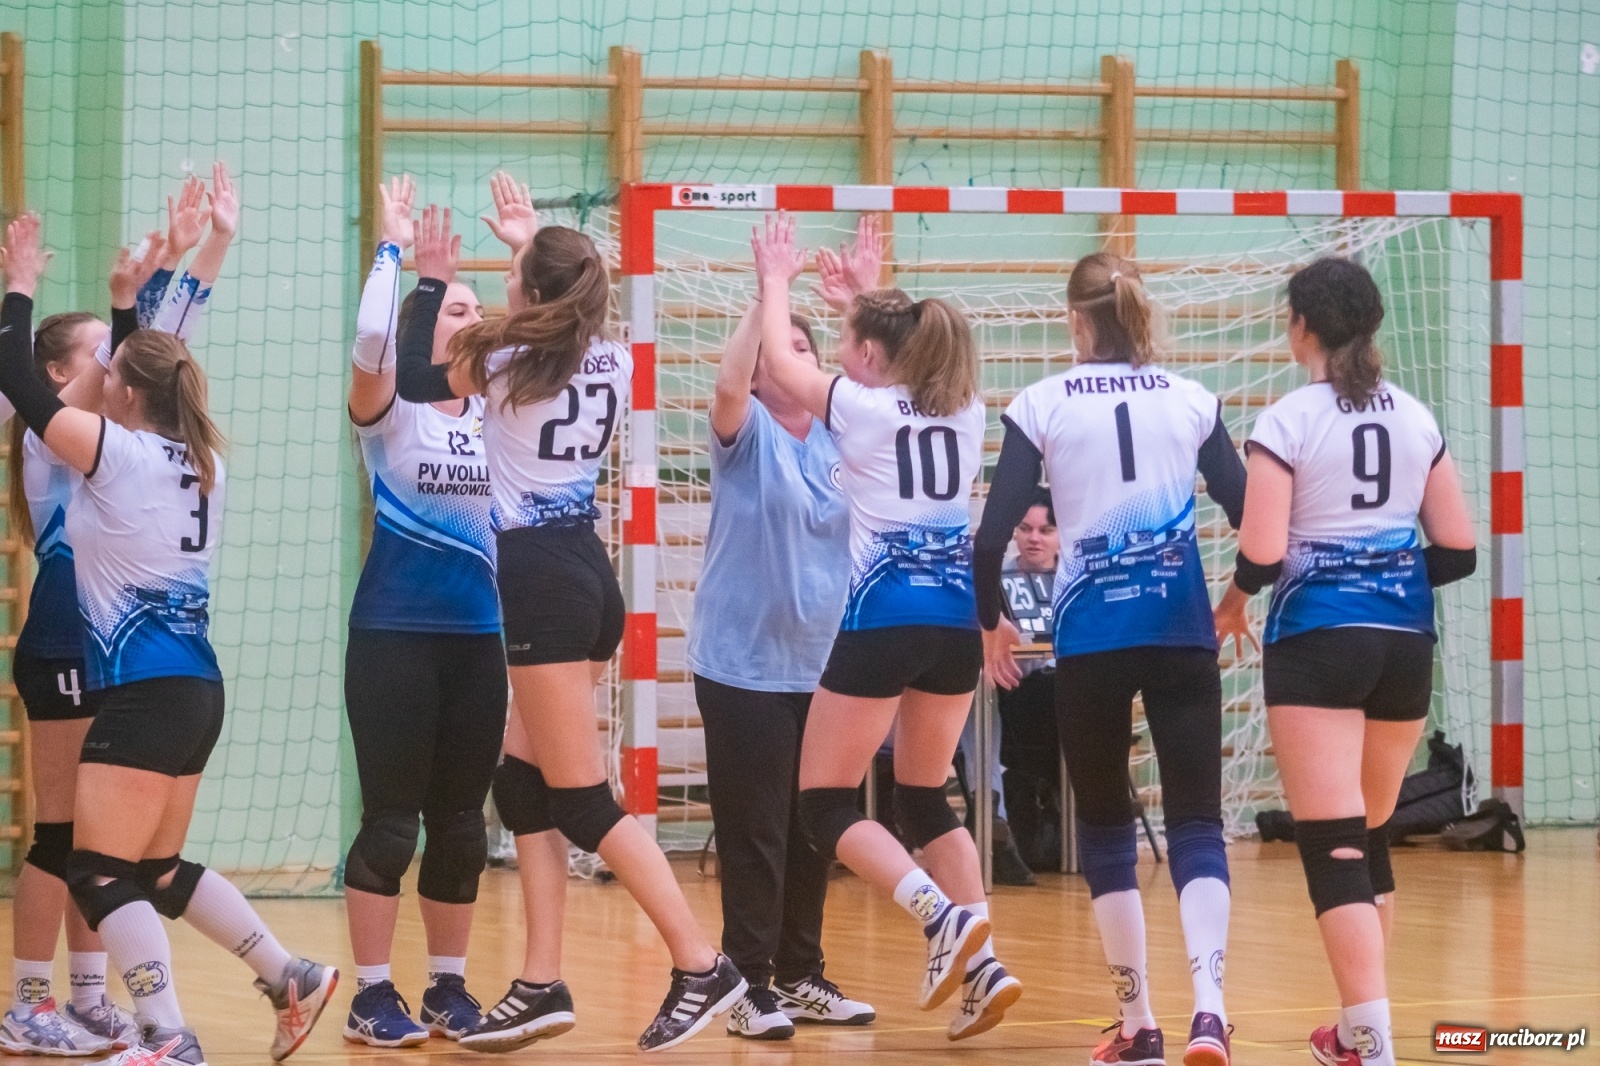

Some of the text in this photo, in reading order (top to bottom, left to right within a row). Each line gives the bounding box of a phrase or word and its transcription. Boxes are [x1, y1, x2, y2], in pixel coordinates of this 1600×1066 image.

[721, 190, 757, 205] sport
[1065, 374, 1170, 397] MIENTUS
[538, 382, 618, 461] 23
[447, 430, 476, 456] 12
[1114, 401, 1137, 483] 1
[418, 462, 443, 481] PV
[895, 424, 960, 501] 10
[1351, 423, 1392, 511] 9
[180, 474, 209, 552] 3
[1002, 577, 1034, 611] 25
[58, 669, 81, 706] 4
